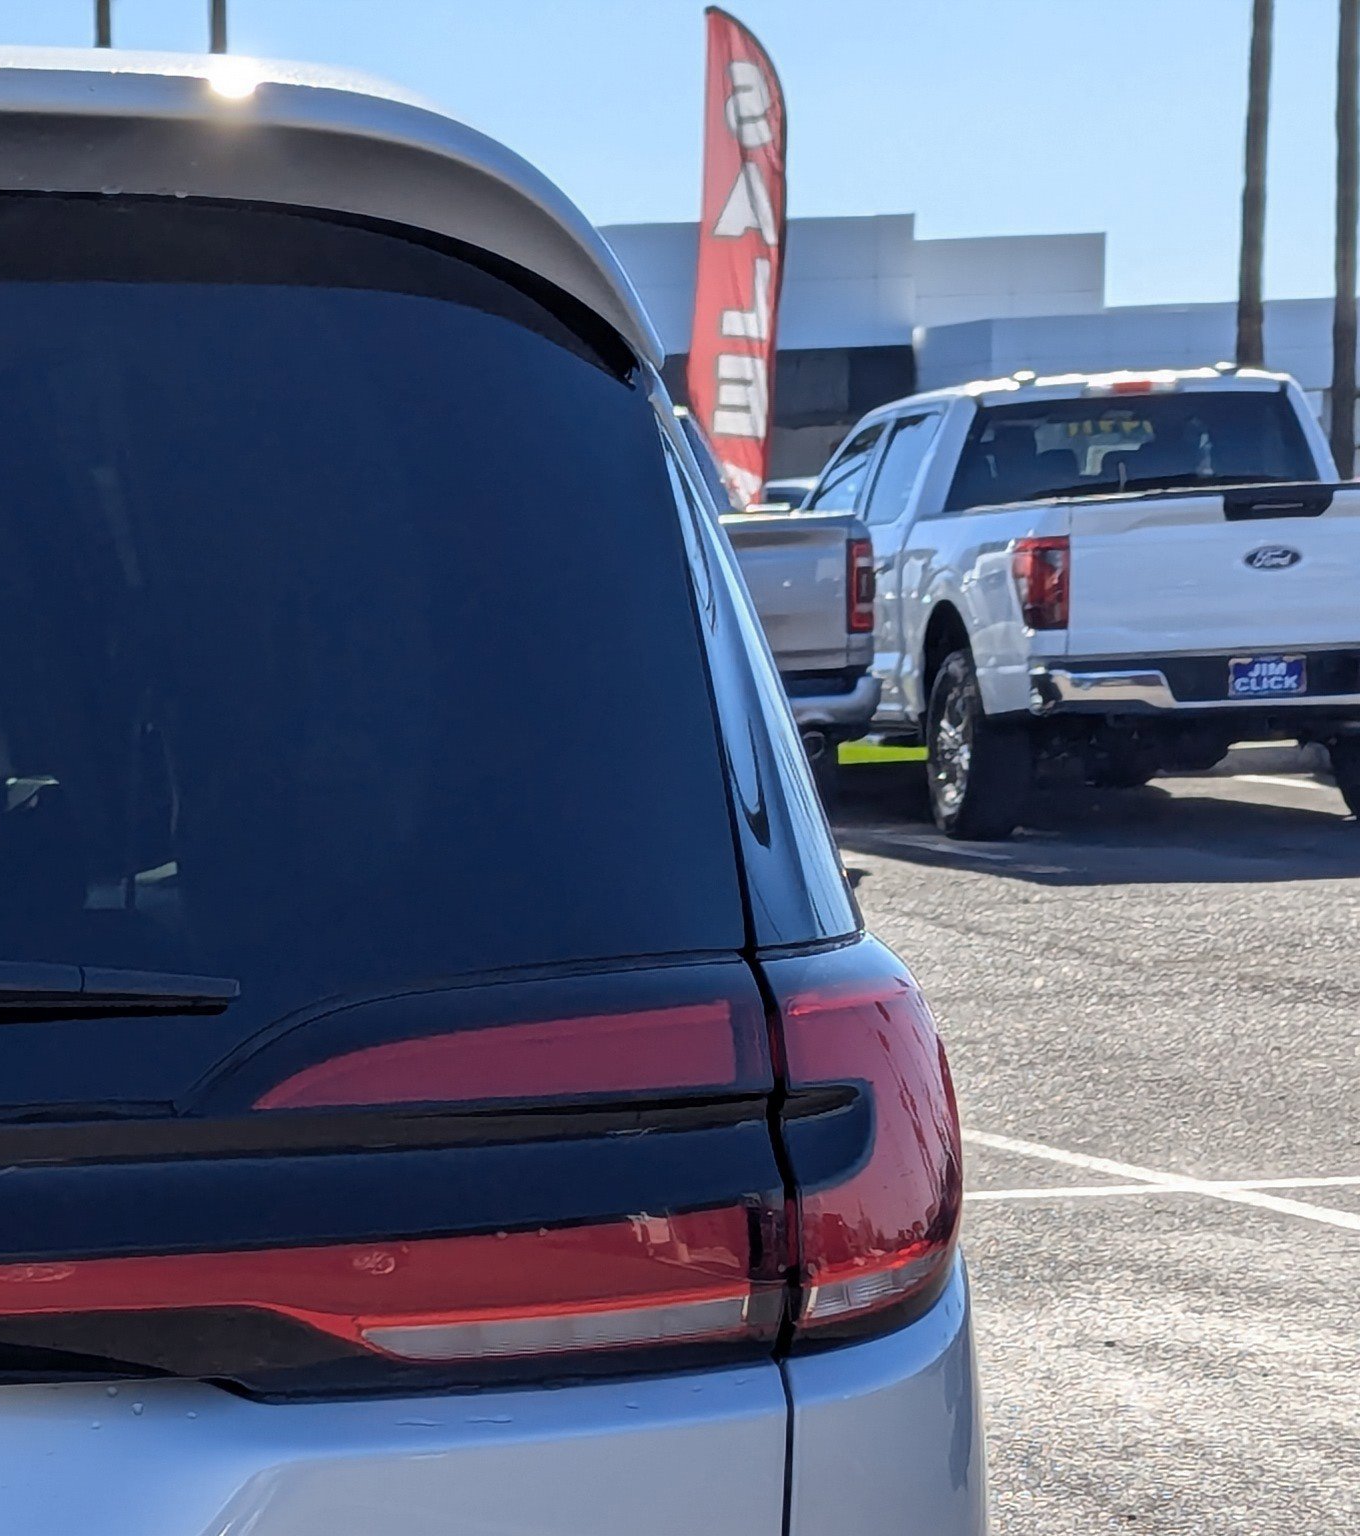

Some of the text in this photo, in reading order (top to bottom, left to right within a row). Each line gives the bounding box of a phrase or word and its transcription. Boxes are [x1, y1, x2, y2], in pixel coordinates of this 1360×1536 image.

[713, 60, 778, 436] SALE
[1247, 662, 1288, 678] JIM
[1233, 674, 1299, 692] CLICK
